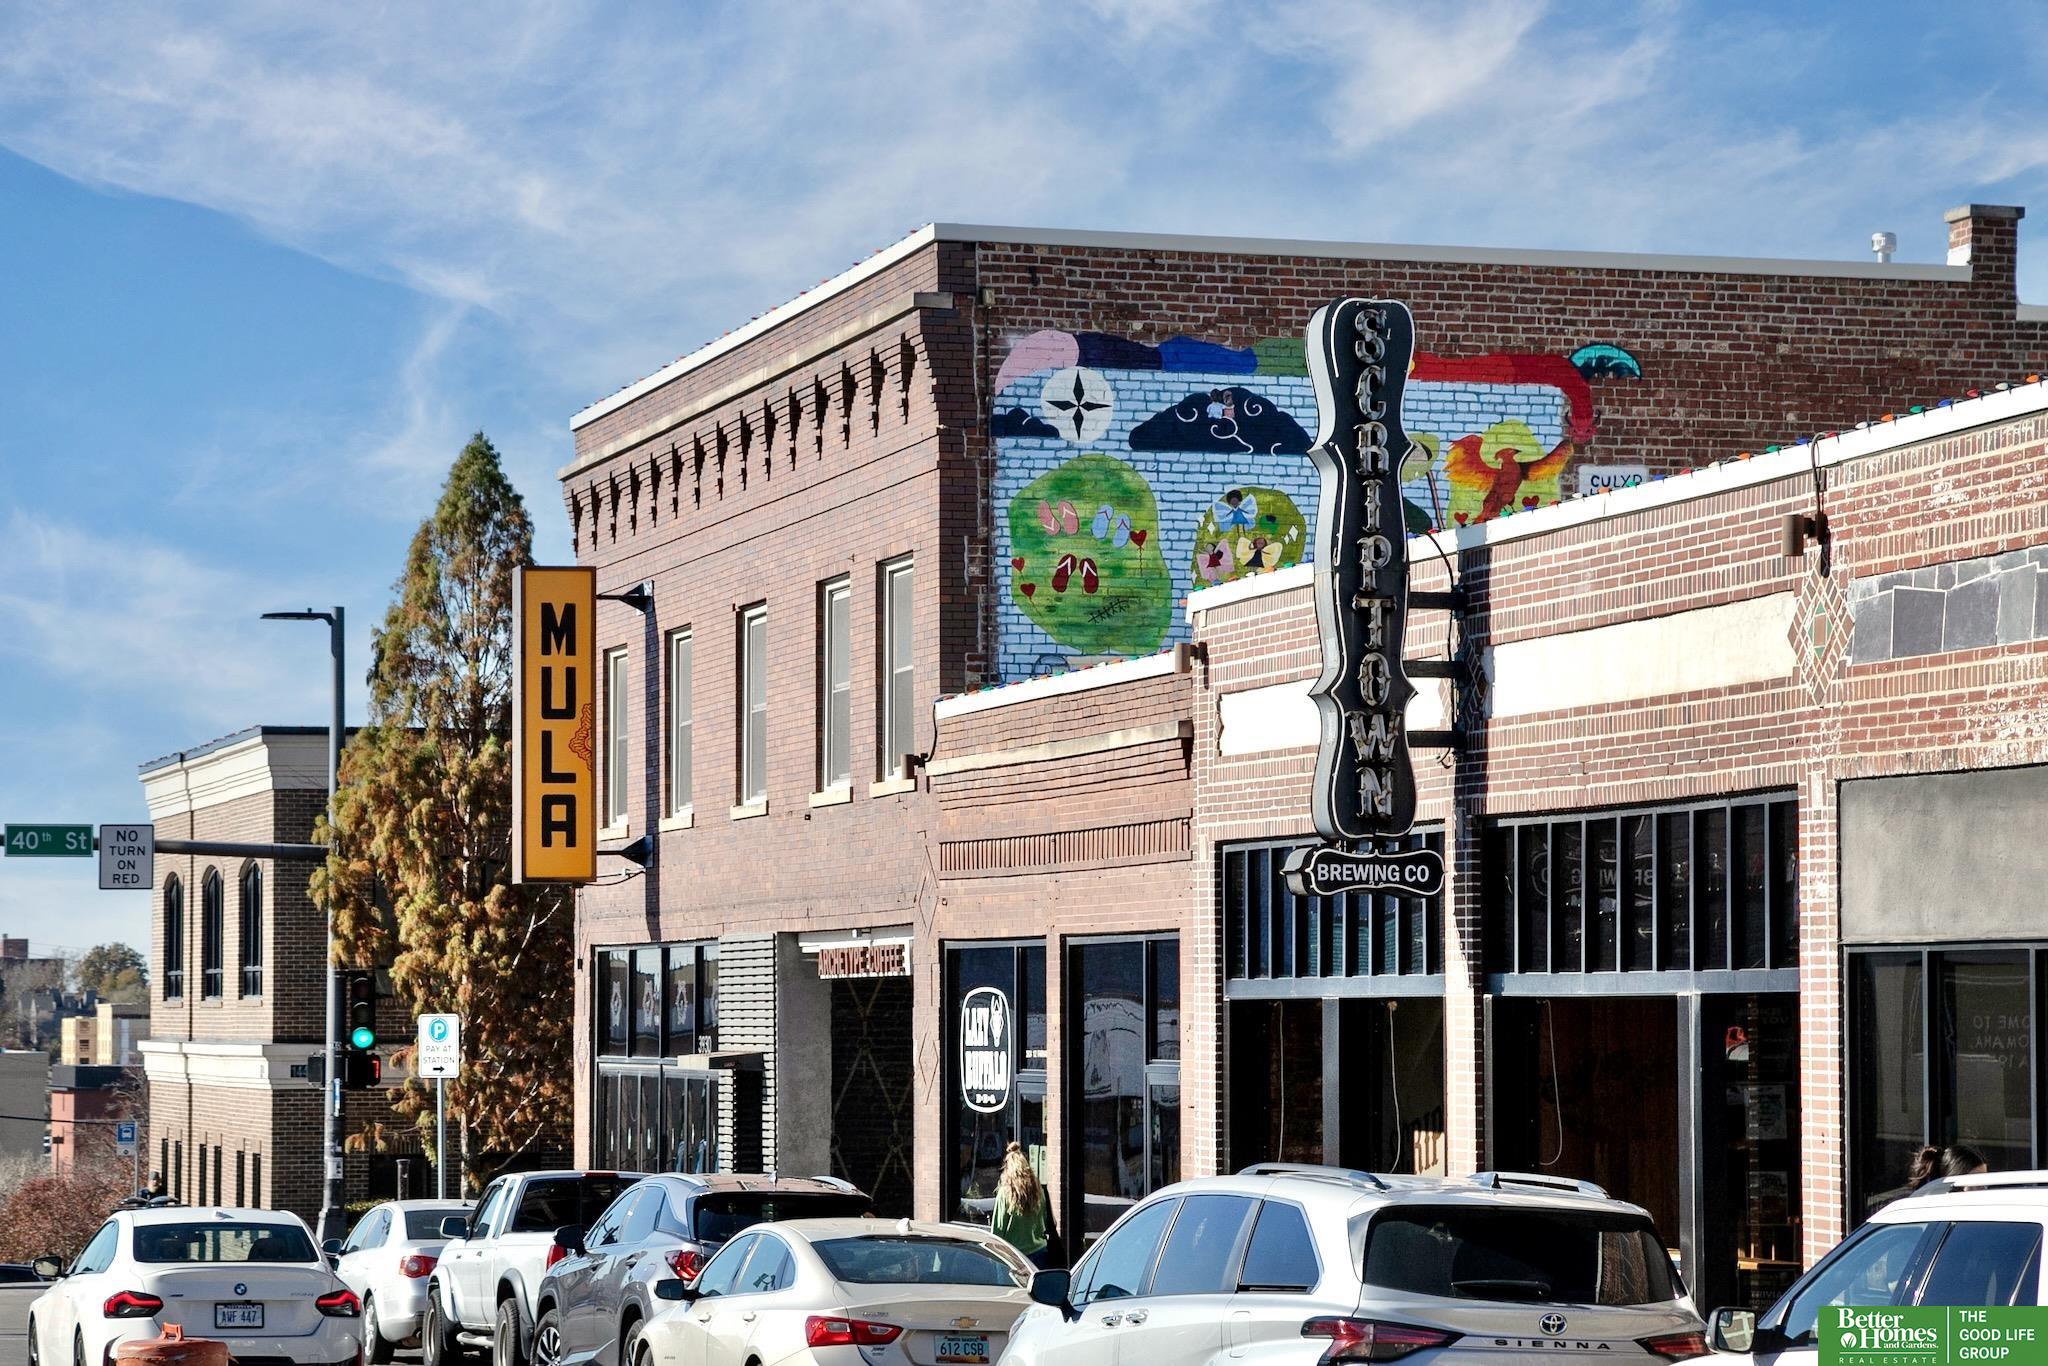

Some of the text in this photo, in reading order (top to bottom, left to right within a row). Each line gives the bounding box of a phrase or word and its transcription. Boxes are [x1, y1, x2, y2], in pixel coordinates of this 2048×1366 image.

[1346, 308, 1403, 820] SCRIPTOWN
[541, 602, 577, 848] MULA
[11, 831, 88, 850] 40th St
[116, 830, 139, 842] NO
[109, 845, 146, 856] TURN
[117, 860, 136, 870] ON
[112, 873, 140, 884] RED
[1317, 863, 1430, 883] BREWING CO
[818, 944, 906, 977] ARCHETYPE COFFEE
[965, 1007, 989, 1047] LAZY
[423, 1056, 455, 1064] STATION
[965, 1050, 1008, 1091] BUFFALO
[241, 1310, 257, 1323] 447
[940, 1343, 984, 1356] 612 CSB
[1494, 1339, 1611, 1350] SIENNA
